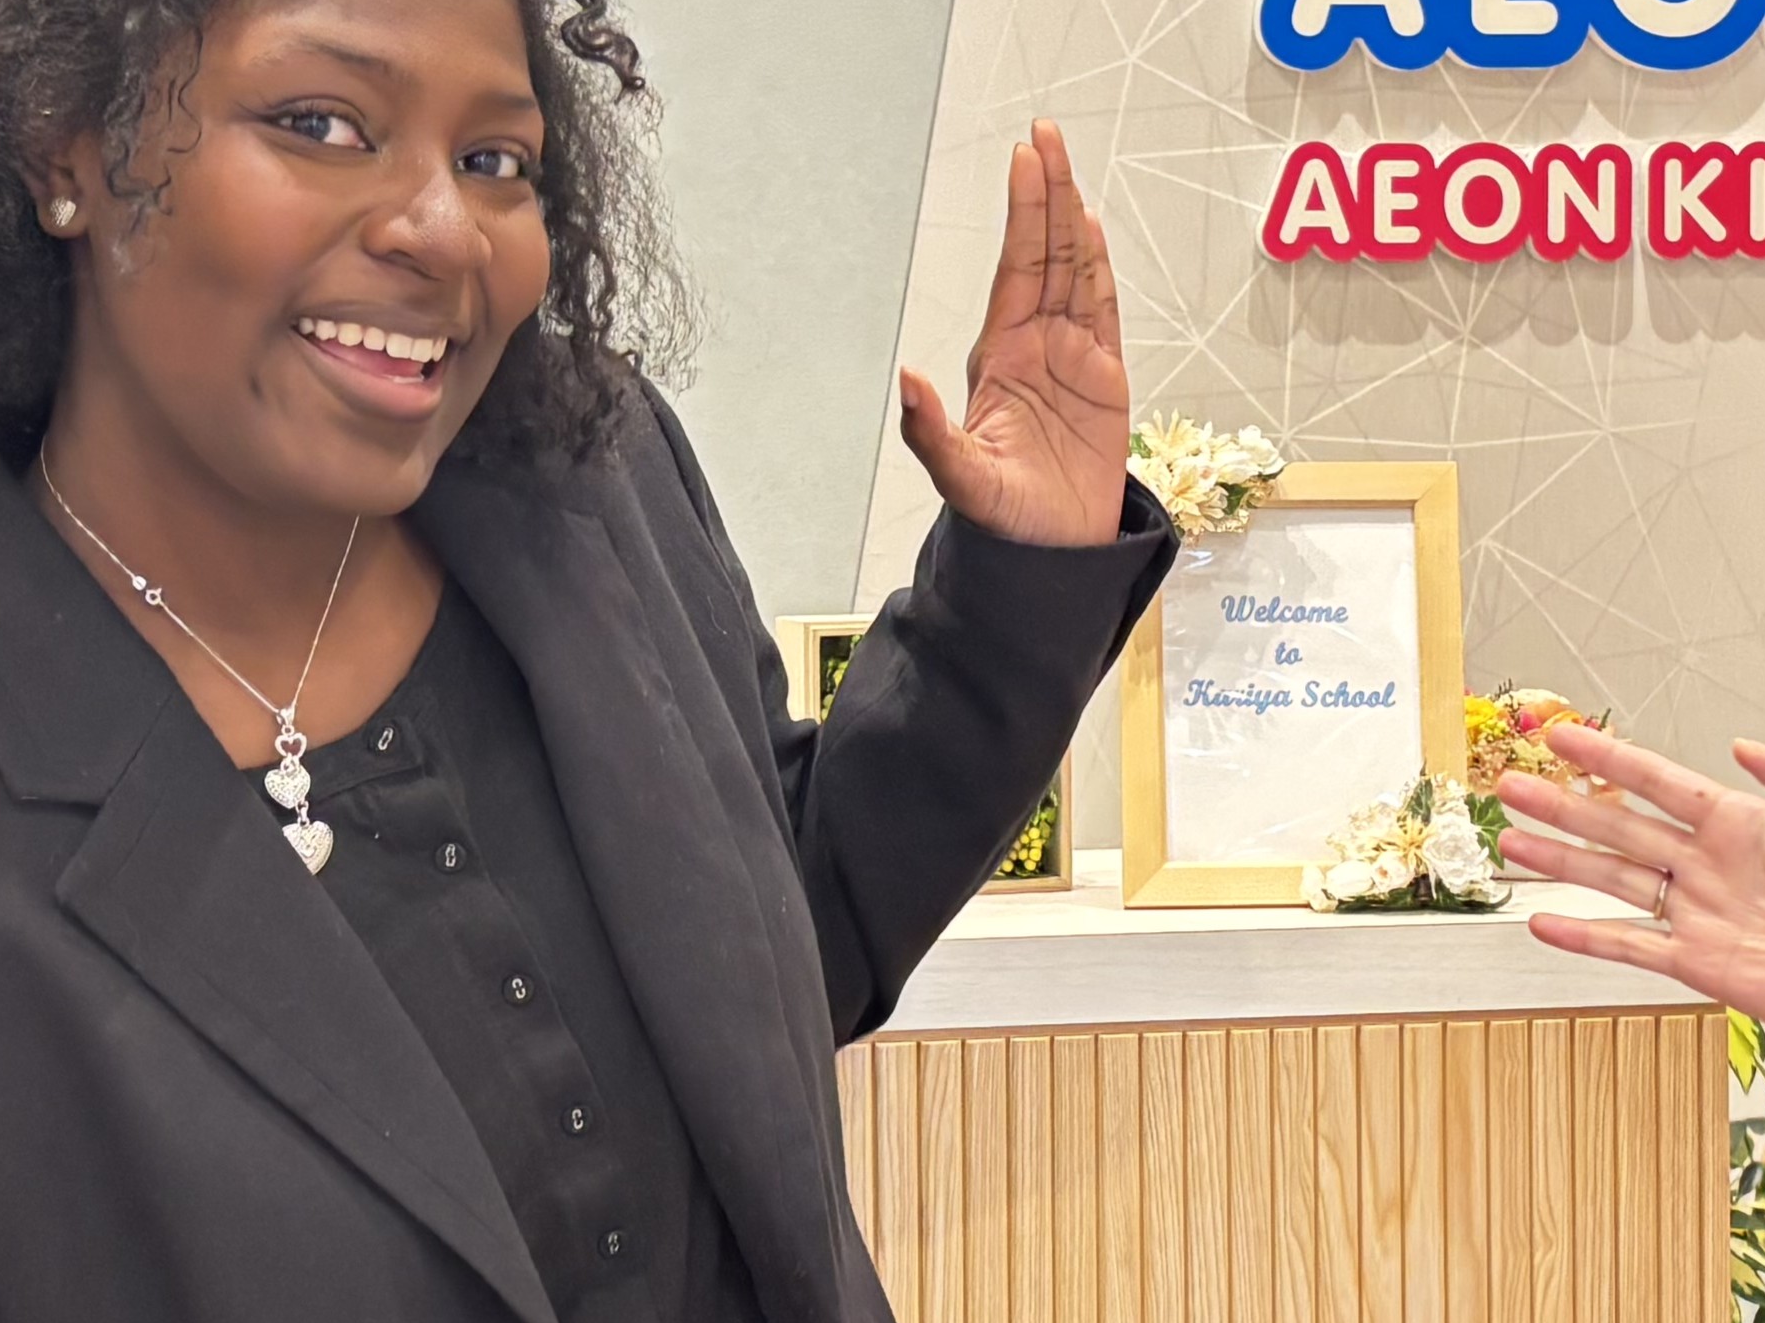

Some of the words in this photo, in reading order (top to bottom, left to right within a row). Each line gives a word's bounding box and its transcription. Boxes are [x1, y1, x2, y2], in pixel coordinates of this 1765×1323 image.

[1276, 156, 1616, 246] AEON
[1221, 595, 1349, 623] Welcome
[1274, 641, 1303, 665] to
[1301, 680, 1396, 708] School
